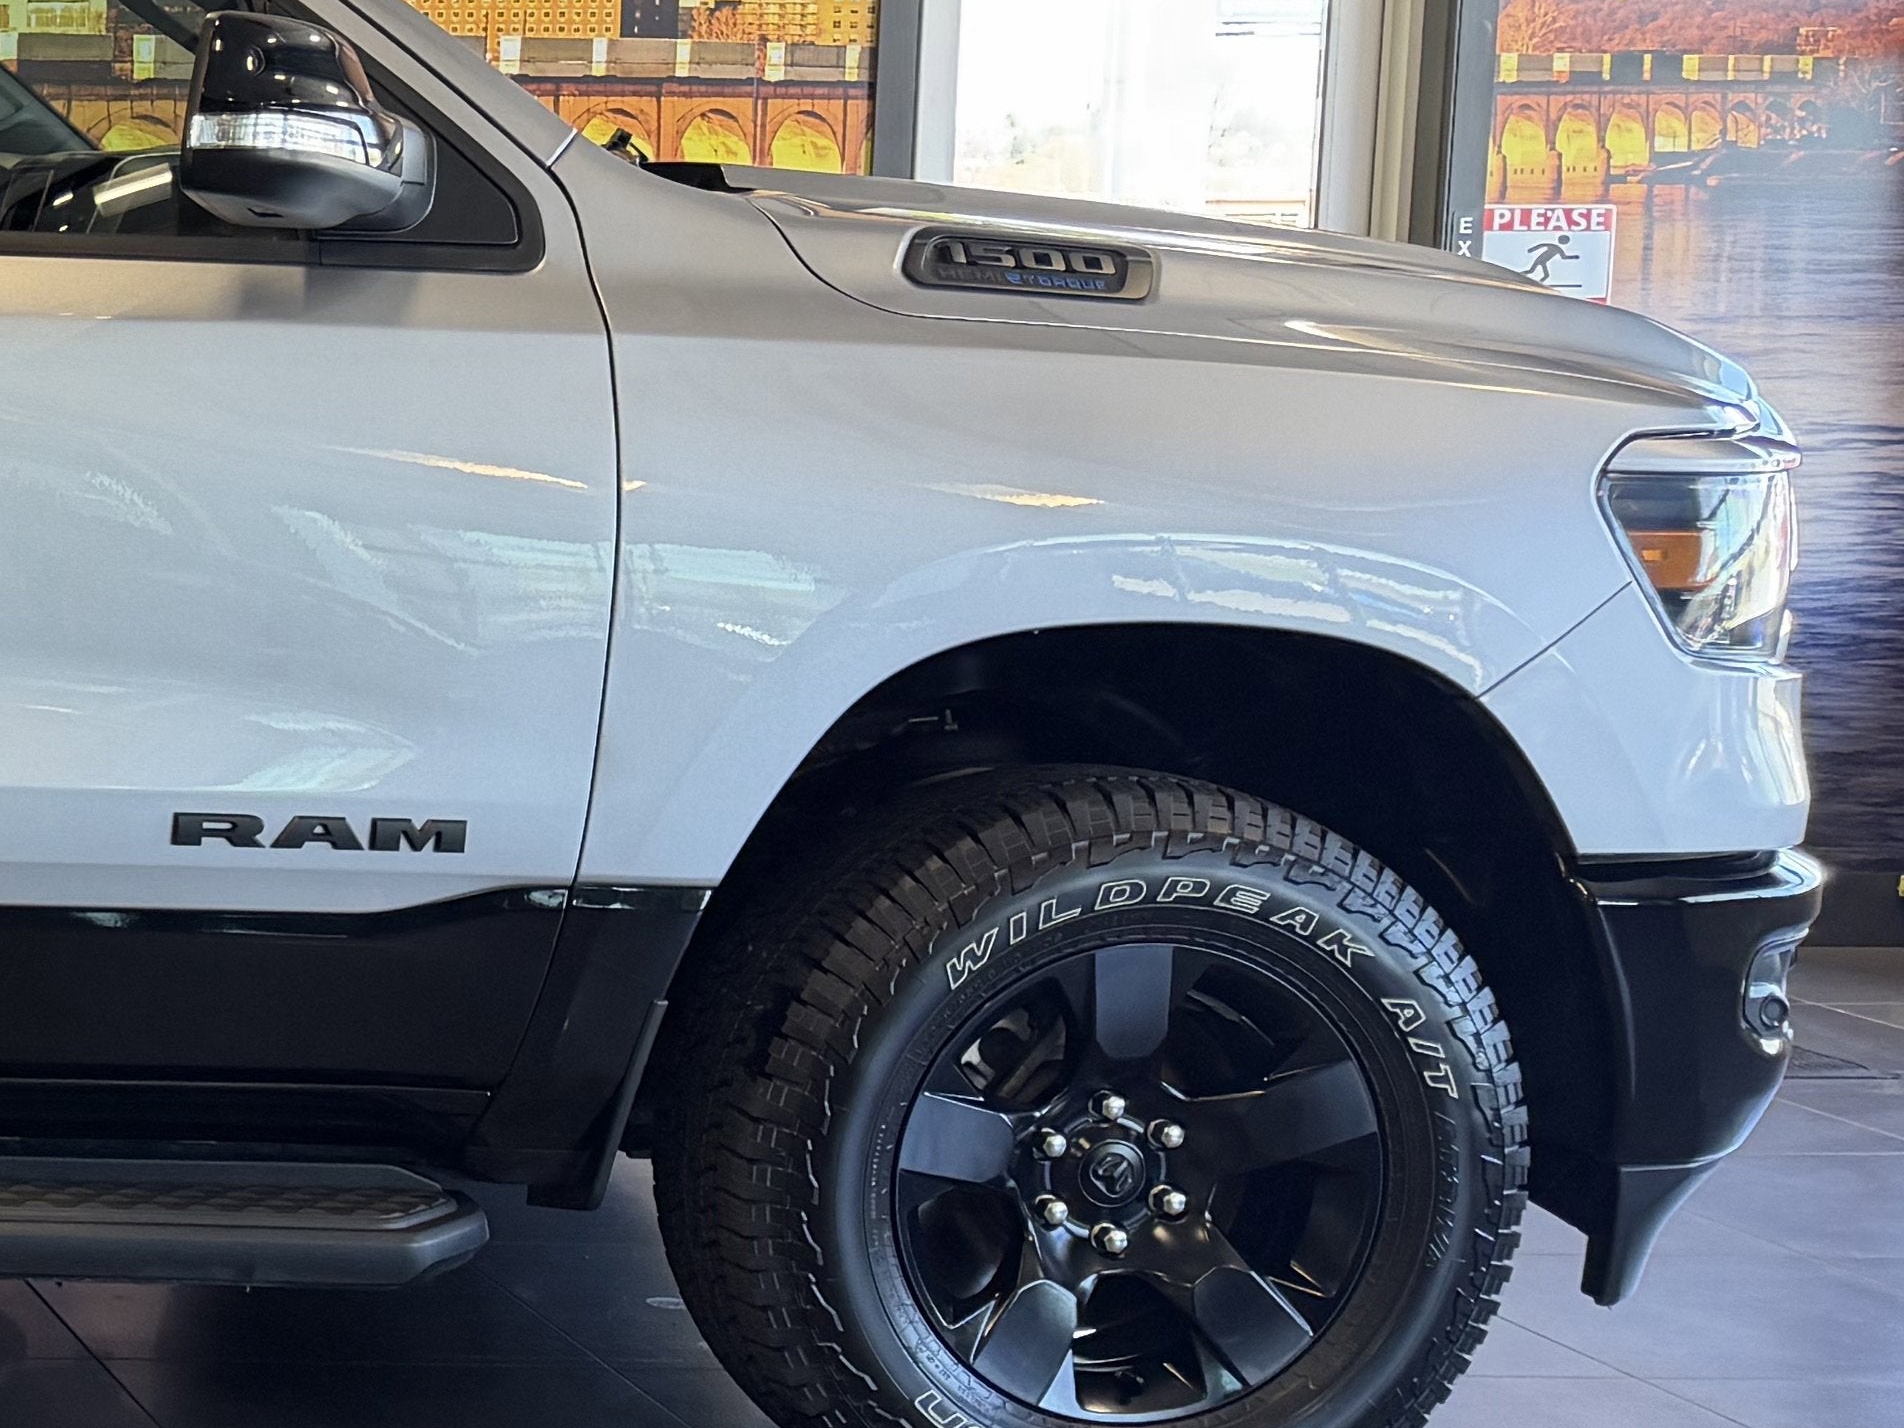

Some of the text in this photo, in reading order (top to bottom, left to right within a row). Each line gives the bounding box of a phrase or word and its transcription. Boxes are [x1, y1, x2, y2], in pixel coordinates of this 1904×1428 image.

[1492, 208, 1606, 232] PLEASE
[934, 241, 1116, 275] 1500
[170, 811, 469, 854] RAM
[944, 876, 1374, 991] WILDPEAK
